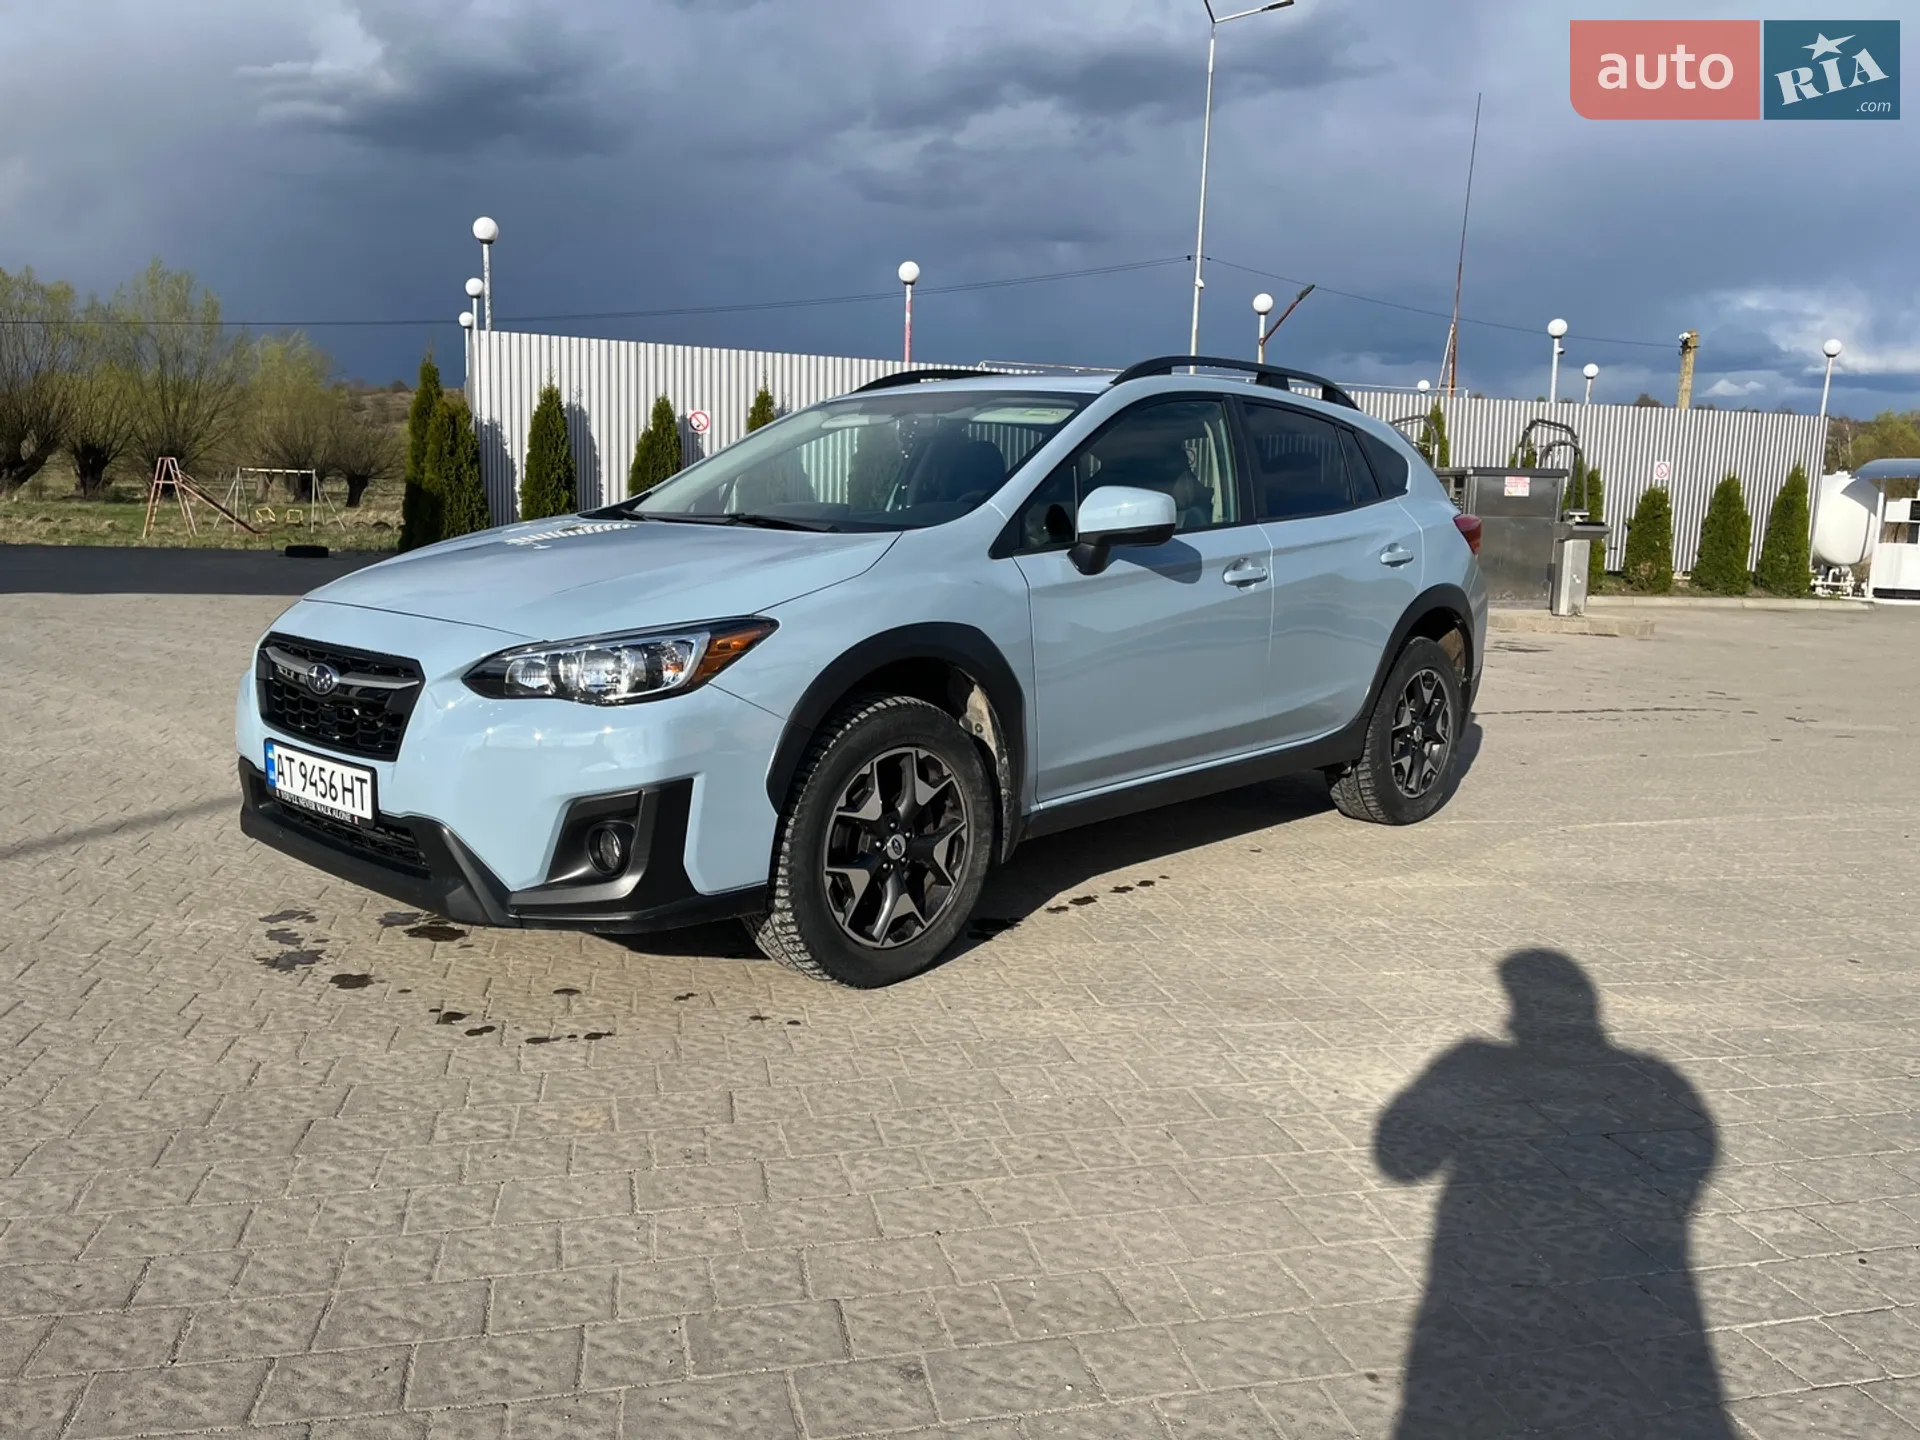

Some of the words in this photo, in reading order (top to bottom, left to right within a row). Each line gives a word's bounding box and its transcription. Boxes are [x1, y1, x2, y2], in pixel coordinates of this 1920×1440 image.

[277, 753, 296, 788] AT
[298, 761, 338, 803] 9456
[341, 772, 368, 811] HT
[316, 803, 332, 816] WALK
[332, 809, 352, 823] ALONE
